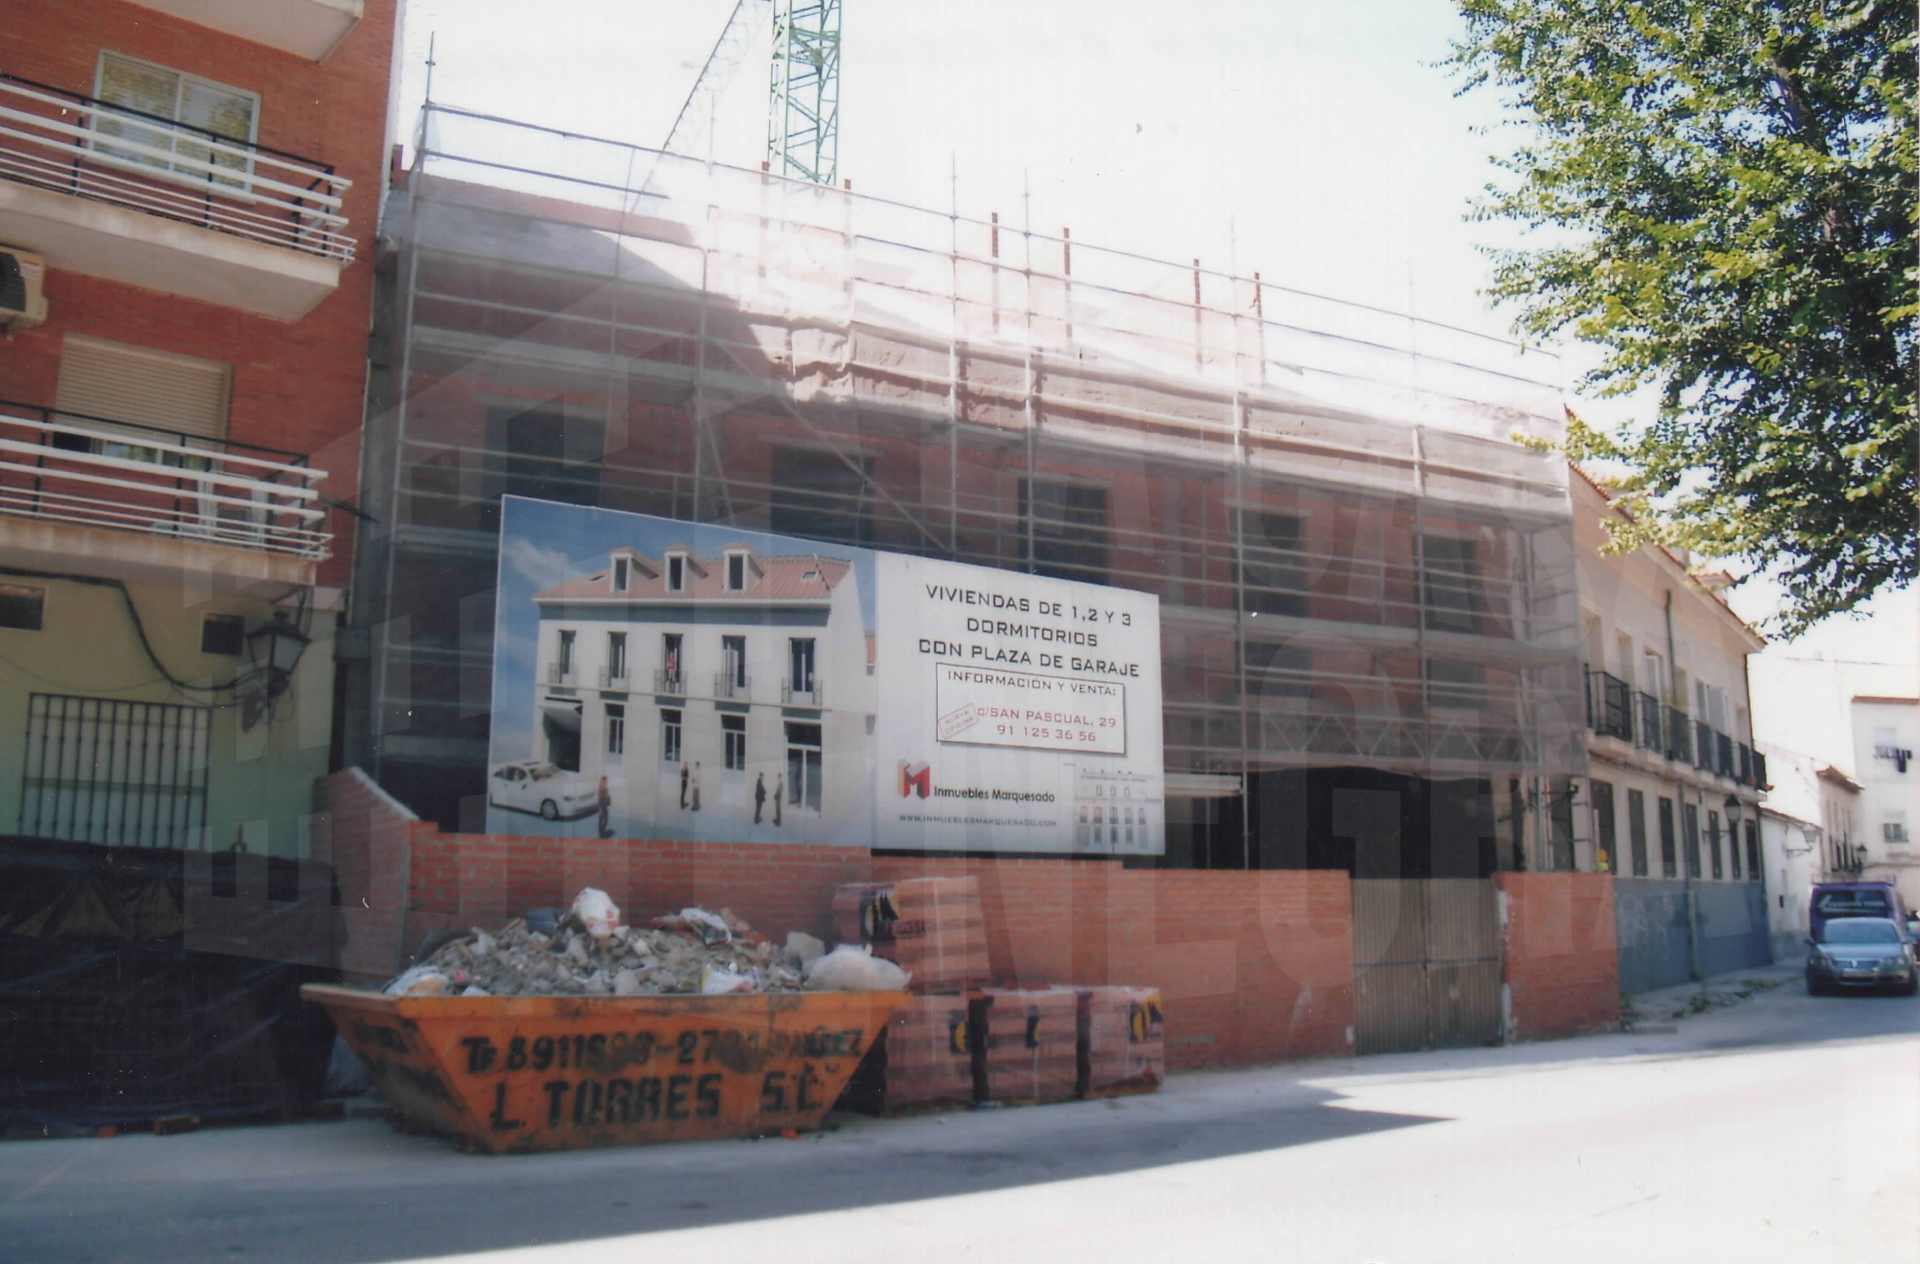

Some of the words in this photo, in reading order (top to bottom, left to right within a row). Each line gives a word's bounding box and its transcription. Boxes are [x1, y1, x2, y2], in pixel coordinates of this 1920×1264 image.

[925, 584, 1030, 613] VIVIENDAS
[1039, 600, 1062, 617] DE
[1104, 610, 1114, 624] Y
[1121, 612, 1131, 627] 3
[967, 617, 1098, 648] DORMITORIOS
[919, 638, 962, 657] CON
[971, 644, 1033, 665] PLAZA
[1039, 653, 1063, 669] DE
[1071, 657, 1140, 678] GARAJE
[1057, 681, 1065, 691] Y
[1070, 684, 1117, 697] VENTA:
[996, 724, 1014, 736] 91
[1023, 726, 1050, 738] 125
[1055, 729, 1073, 741] 36
[1078, 730, 1097, 742] 56
[1098, 716, 1117, 728] 29
[933, 785, 990, 800] Inmuebles
[991, 788, 1056, 804] Marquesado
[543, 1071, 724, 1129] TORRES
